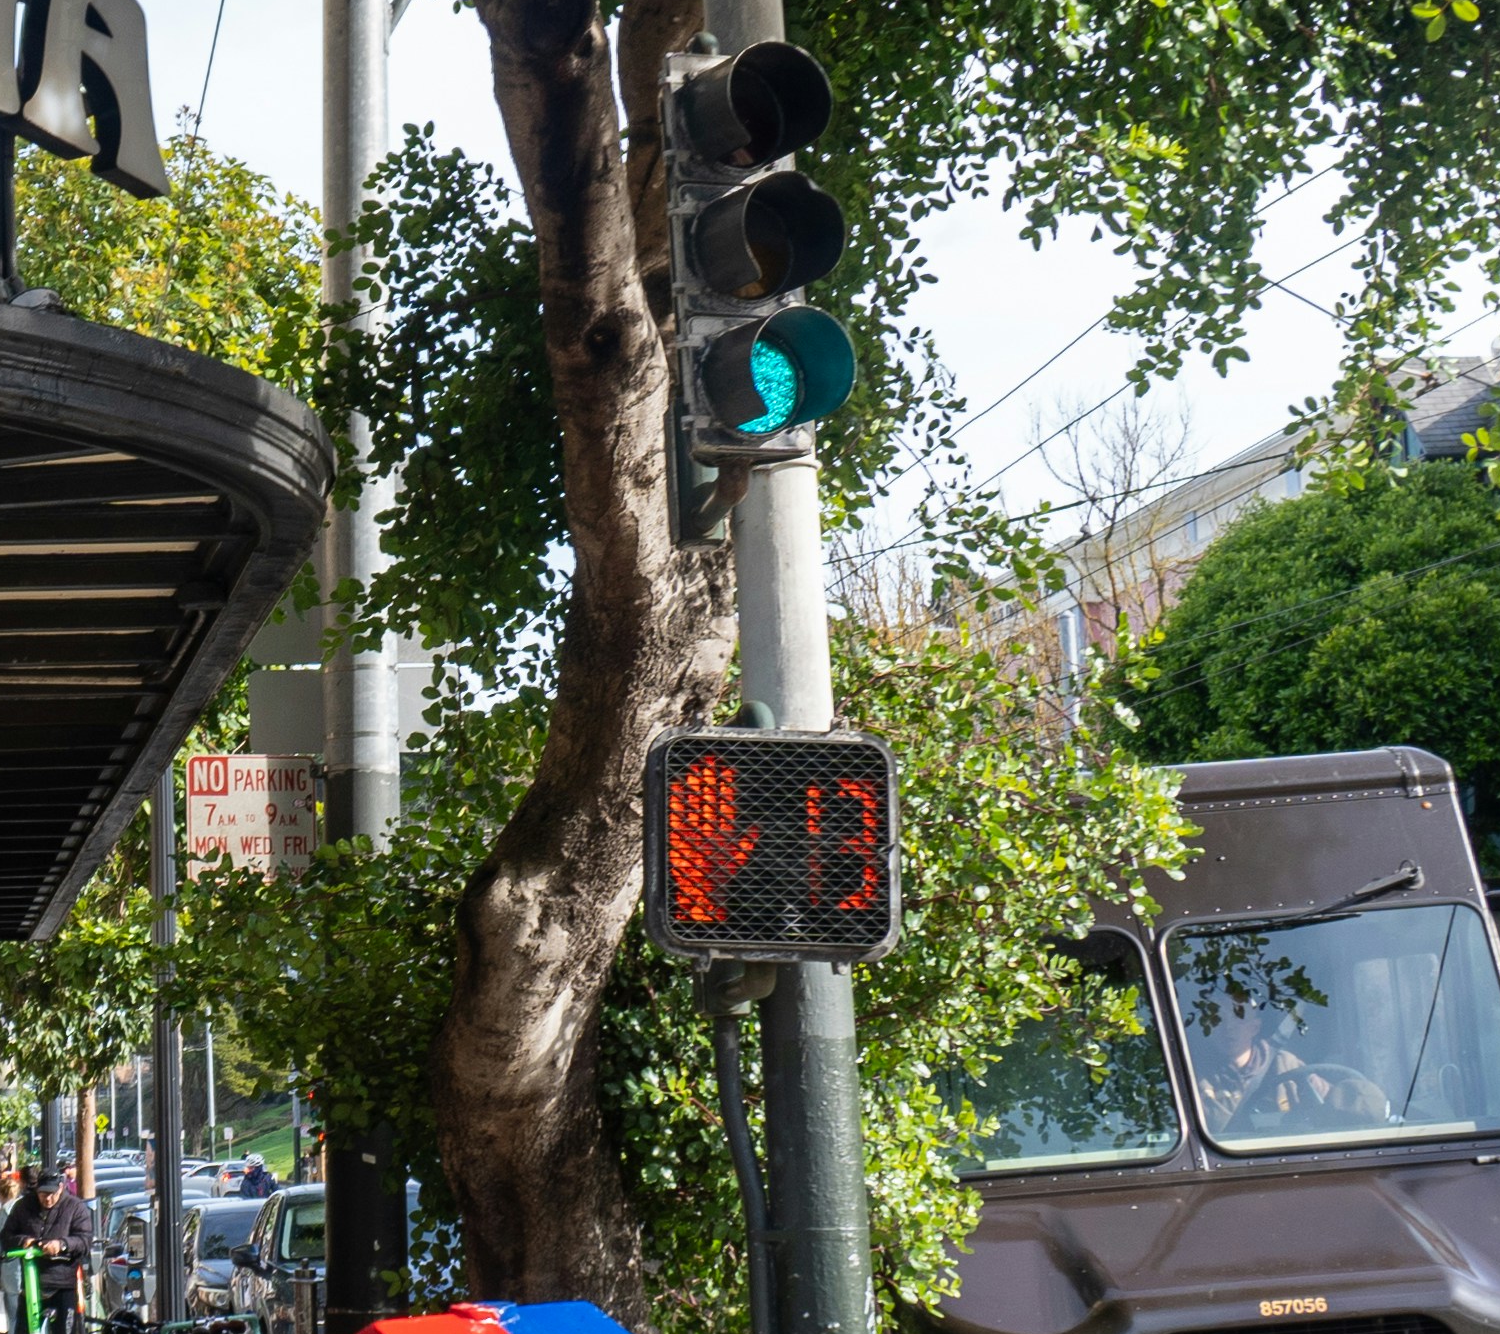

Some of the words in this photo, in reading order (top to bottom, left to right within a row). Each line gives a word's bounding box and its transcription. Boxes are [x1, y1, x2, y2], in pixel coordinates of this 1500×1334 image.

[192, 759, 226, 793] NO
[233, 768, 308, 792] PARKING
[204, 803, 217, 827] 7
[245, 814, 256, 823] TO
[265, 802, 278, 825] 9
[1259, 1297, 1328, 1317] 857056
